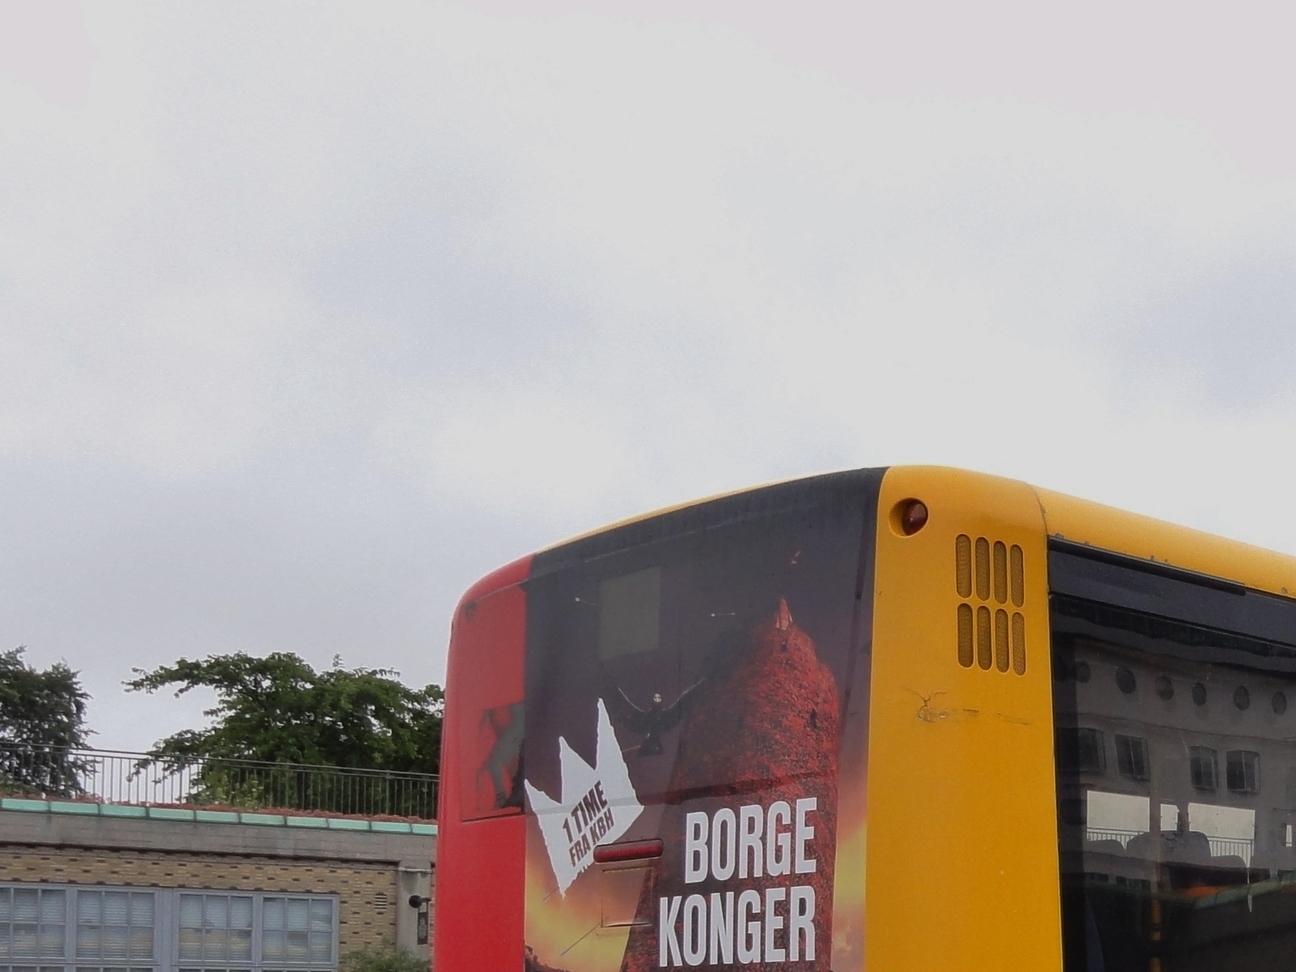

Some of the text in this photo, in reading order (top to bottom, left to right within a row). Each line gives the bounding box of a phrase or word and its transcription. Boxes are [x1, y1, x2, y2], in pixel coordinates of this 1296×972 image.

[562, 780, 608, 844] 1 TIME
[569, 807, 614, 867] FRA KBH
[685, 797, 818, 884] BORGE
[659, 885, 816, 967] KONGER
